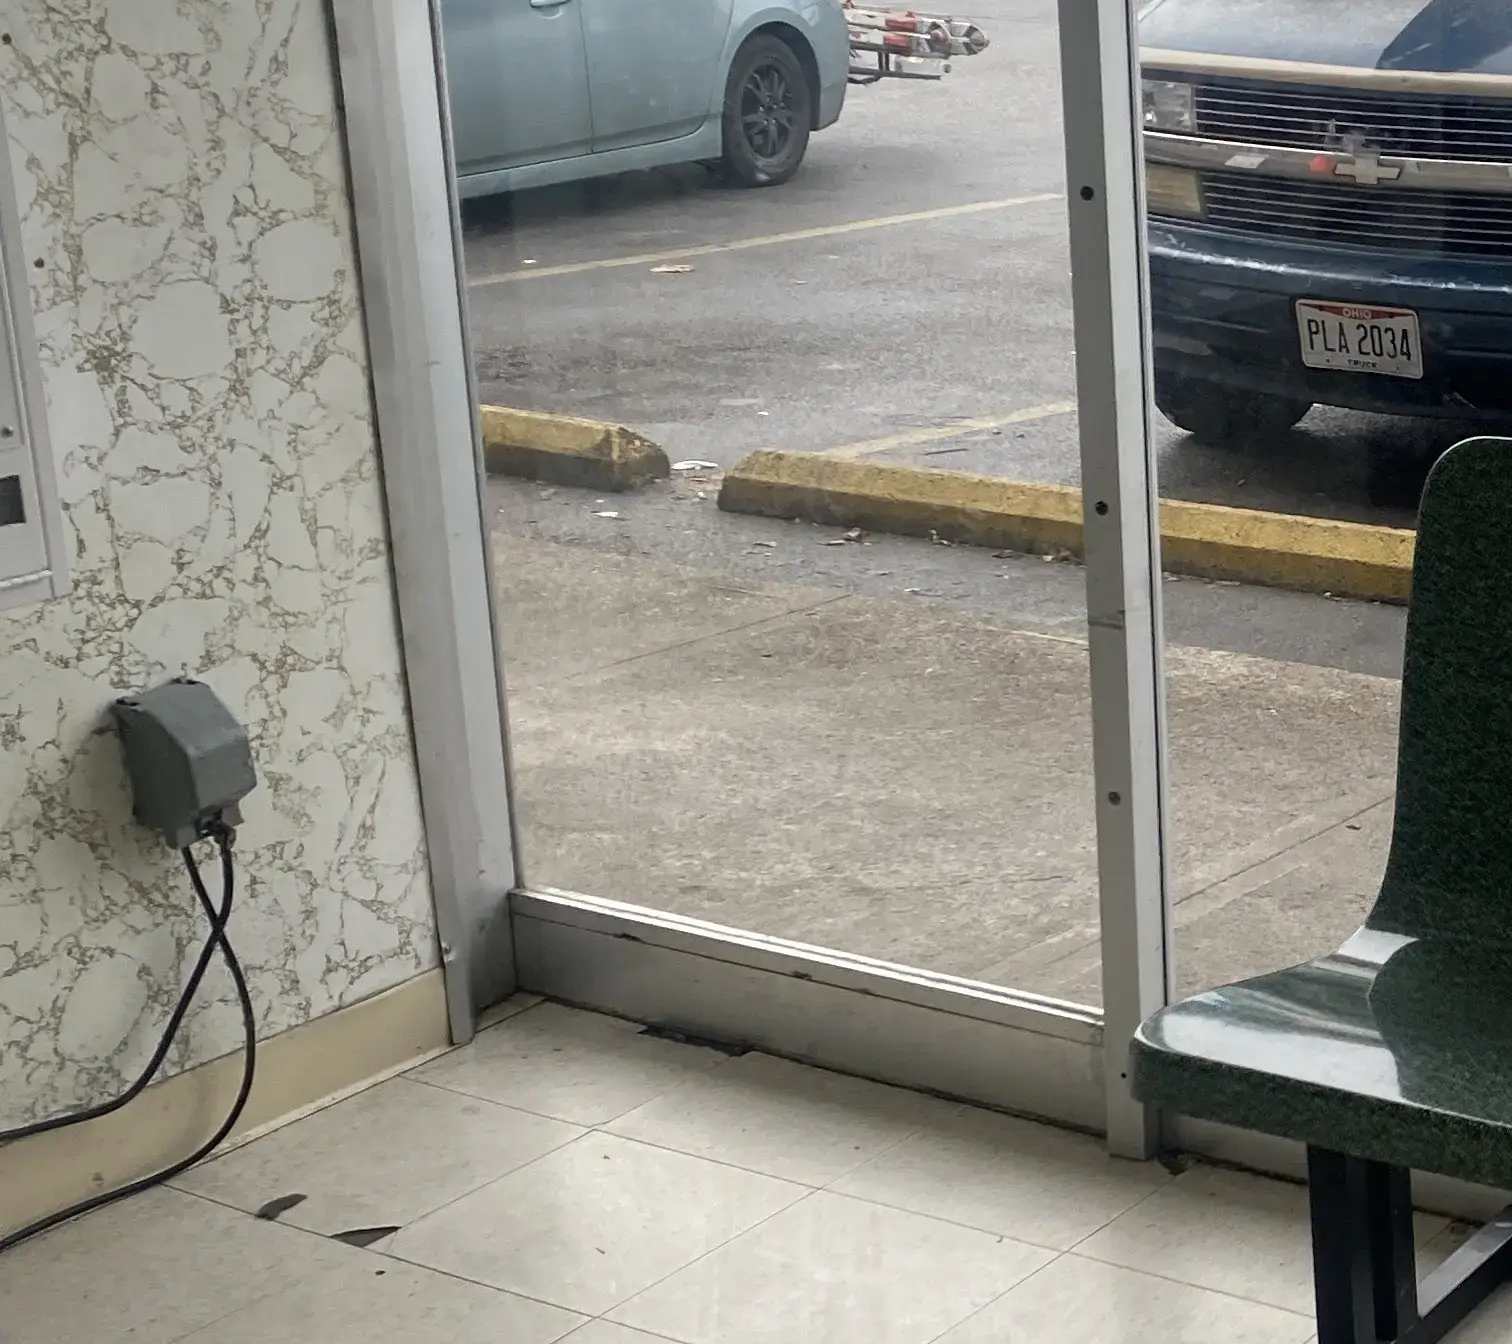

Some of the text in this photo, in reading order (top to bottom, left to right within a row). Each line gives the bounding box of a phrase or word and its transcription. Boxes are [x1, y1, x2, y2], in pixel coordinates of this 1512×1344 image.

[1342, 307, 1372, 320] OHIO
[1307, 318, 1412, 362] PLA 2034
